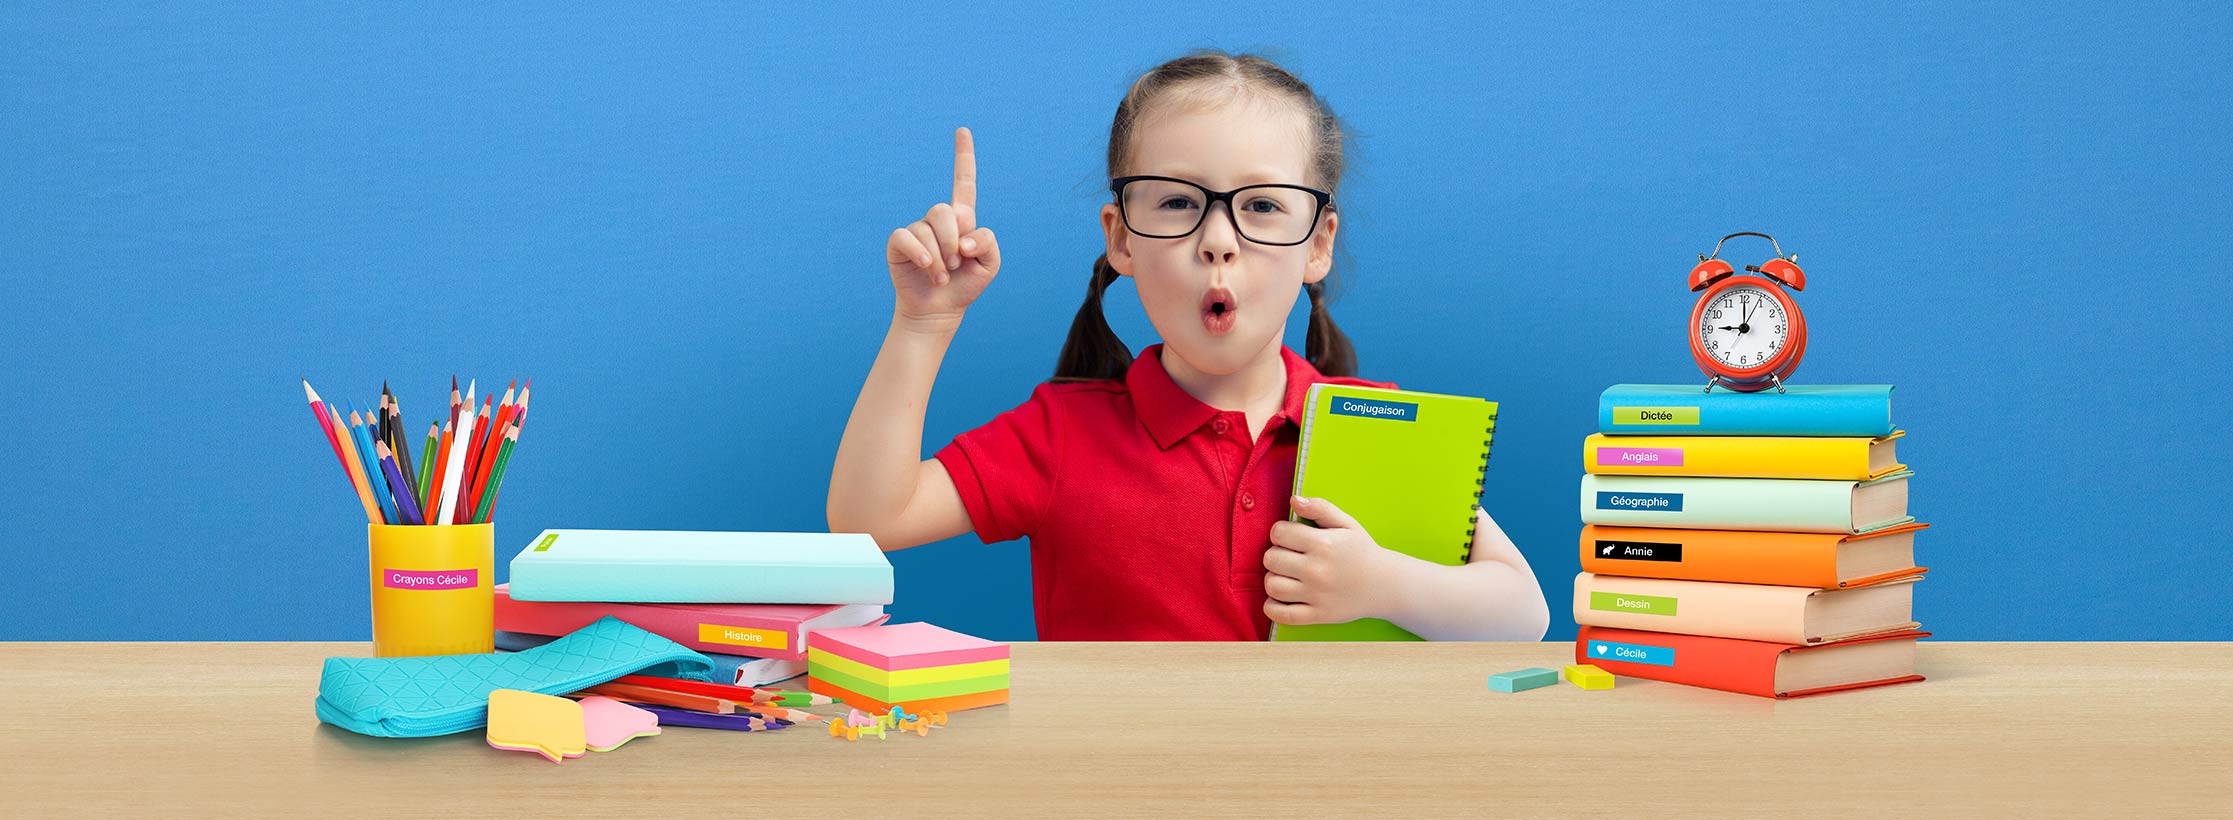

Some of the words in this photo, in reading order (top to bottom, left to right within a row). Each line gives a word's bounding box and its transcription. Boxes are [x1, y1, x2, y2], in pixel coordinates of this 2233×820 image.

[1724, 299, 1733, 308] 11
[1740, 294, 1750, 304] 12
[1712, 310, 1722, 319] 10
[1769, 309, 1775, 318] 2
[1707, 325, 1713, 334] 9
[1775, 325, 1781, 334] 3
[1712, 341, 1718, 350] 8
[1769, 341, 1775, 350] 4
[1724, 352, 1731, 361] 7
[1740, 355, 1746, 364] 6
[1757, 352, 1763, 361] 5
[1343, 401, 1405, 416] Conjugaison
[1640, 410, 1673, 421] Dictée
[1621, 451, 1659, 463] Anglais
[1610, 496, 1669, 509] Géographie
[1624, 546, 1653, 557] Annie
[392, 573, 435, 587] Crayons
[436, 574, 468, 585] Cécile
[1616, 598, 1651, 610] Dessin
[724, 629, 762, 642] Histoire
[1615, 647, 1647, 660] Cécile
